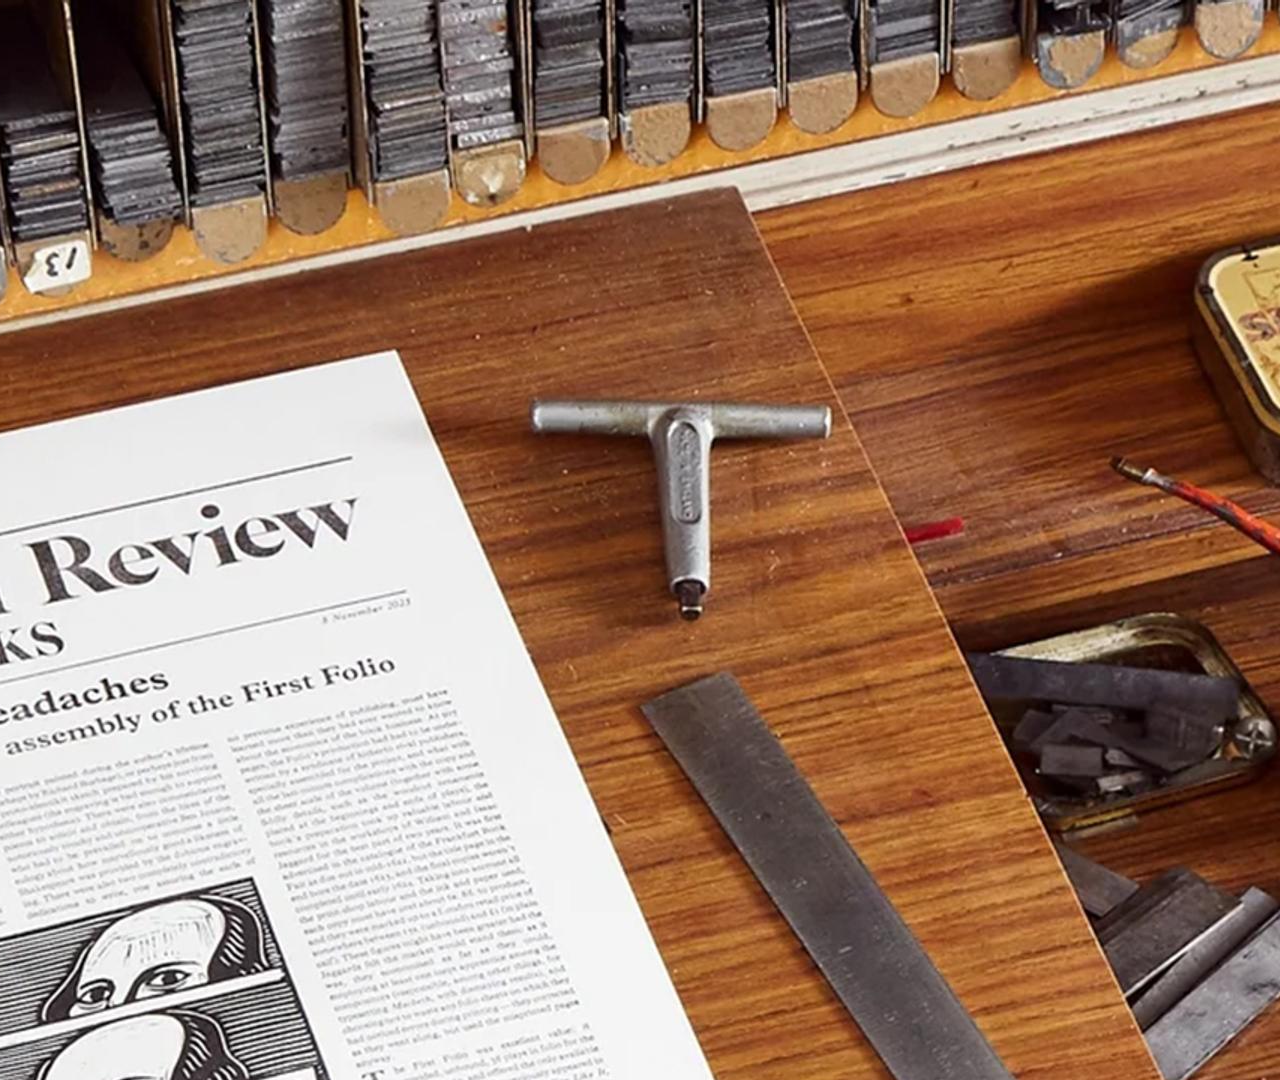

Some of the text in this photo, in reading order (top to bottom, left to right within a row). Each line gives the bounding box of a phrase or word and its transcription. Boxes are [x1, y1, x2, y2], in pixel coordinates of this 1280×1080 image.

[24, 497, 358, 605] Review
[330, 604, 384, 623] November
[5, 712, 141, 756] assembly
[150, 699, 181, 723] of
[186, 694, 235, 715] the
[240, 675, 315, 703] First
[319, 657, 396, 686] Folio
[411, 1058, 437, 1072] First
[442, 1051, 469, 1064] Folio
[500, 1034, 542, 1050] excellent
